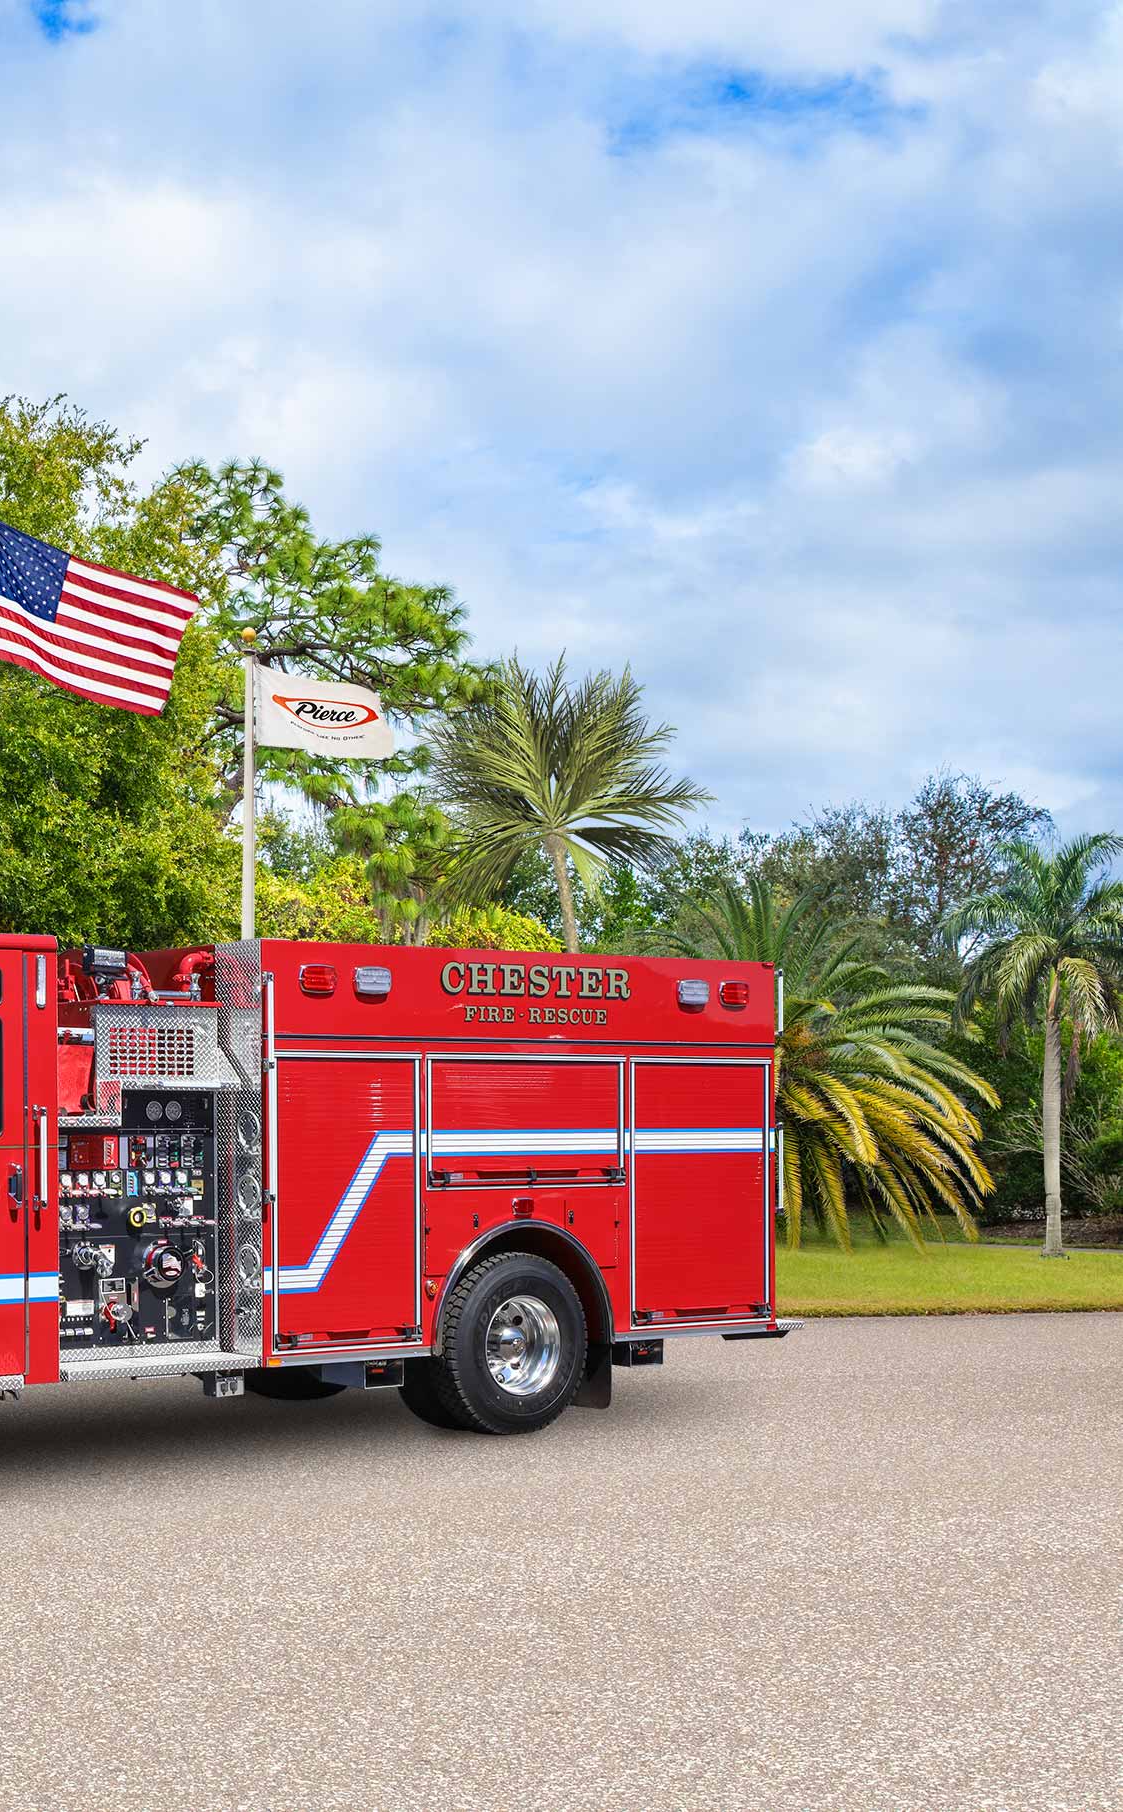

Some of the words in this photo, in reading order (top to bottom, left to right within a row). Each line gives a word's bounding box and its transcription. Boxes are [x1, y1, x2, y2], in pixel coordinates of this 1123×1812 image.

[295, 701, 356, 722] Pierce
[441, 961, 631, 1001] CHESTER
[464, 1005, 515, 1023] FIRE
[528, 1007, 607, 1026] RESCUE
